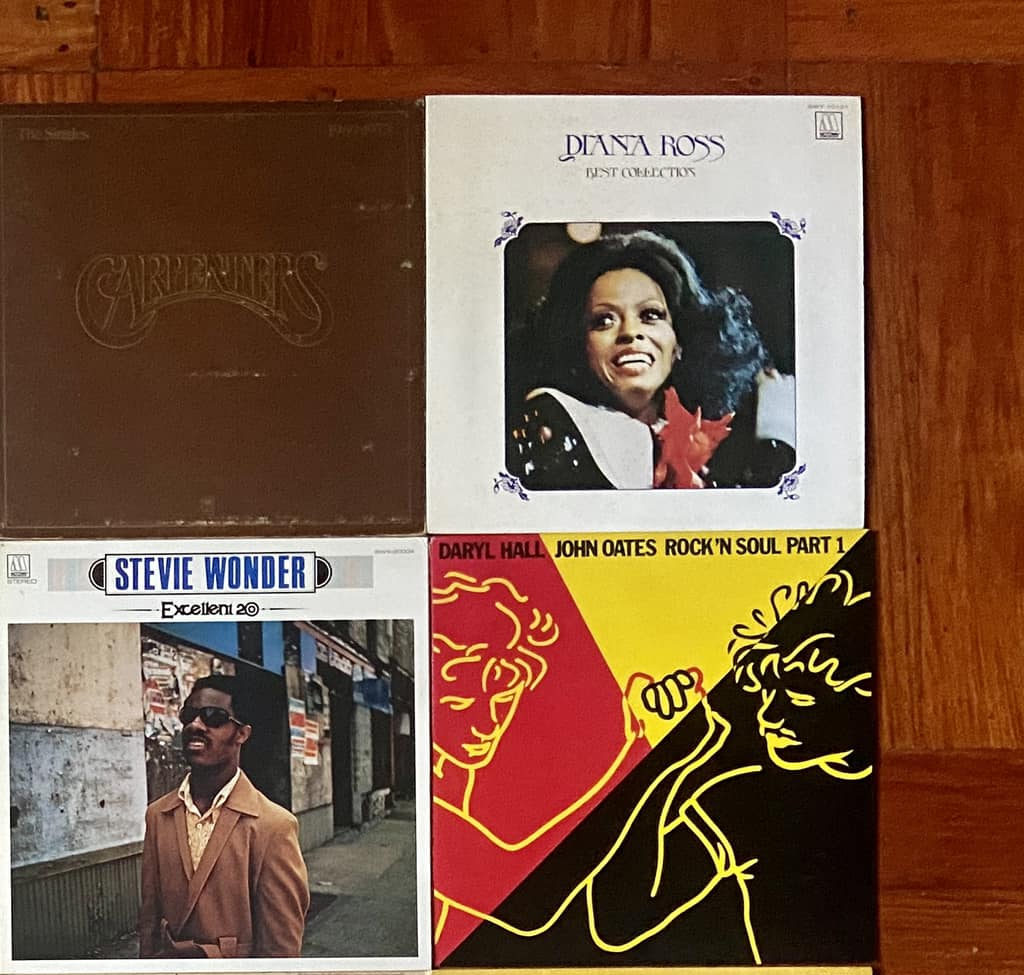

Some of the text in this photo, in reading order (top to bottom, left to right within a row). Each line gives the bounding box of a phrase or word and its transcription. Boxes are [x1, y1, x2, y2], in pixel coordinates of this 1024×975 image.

[558, 134, 726, 163] DIANA ROSS
[586, 167, 696, 179] BEST COLLECTION
[76, 251, 334, 350] CARPENTERS
[439, 542, 496, 559] DARYL
[501, 541, 545, 558] HALL
[555, 540, 598, 558] JOHN
[602, 539, 657, 557] OATES
[736, 537, 781, 554] SOUL
[787, 536, 831, 554] PART
[836, 536, 845, 553] 1
[115, 555, 305, 591] STEVIE WONDER
[161, 601, 233, 618] Excellent
